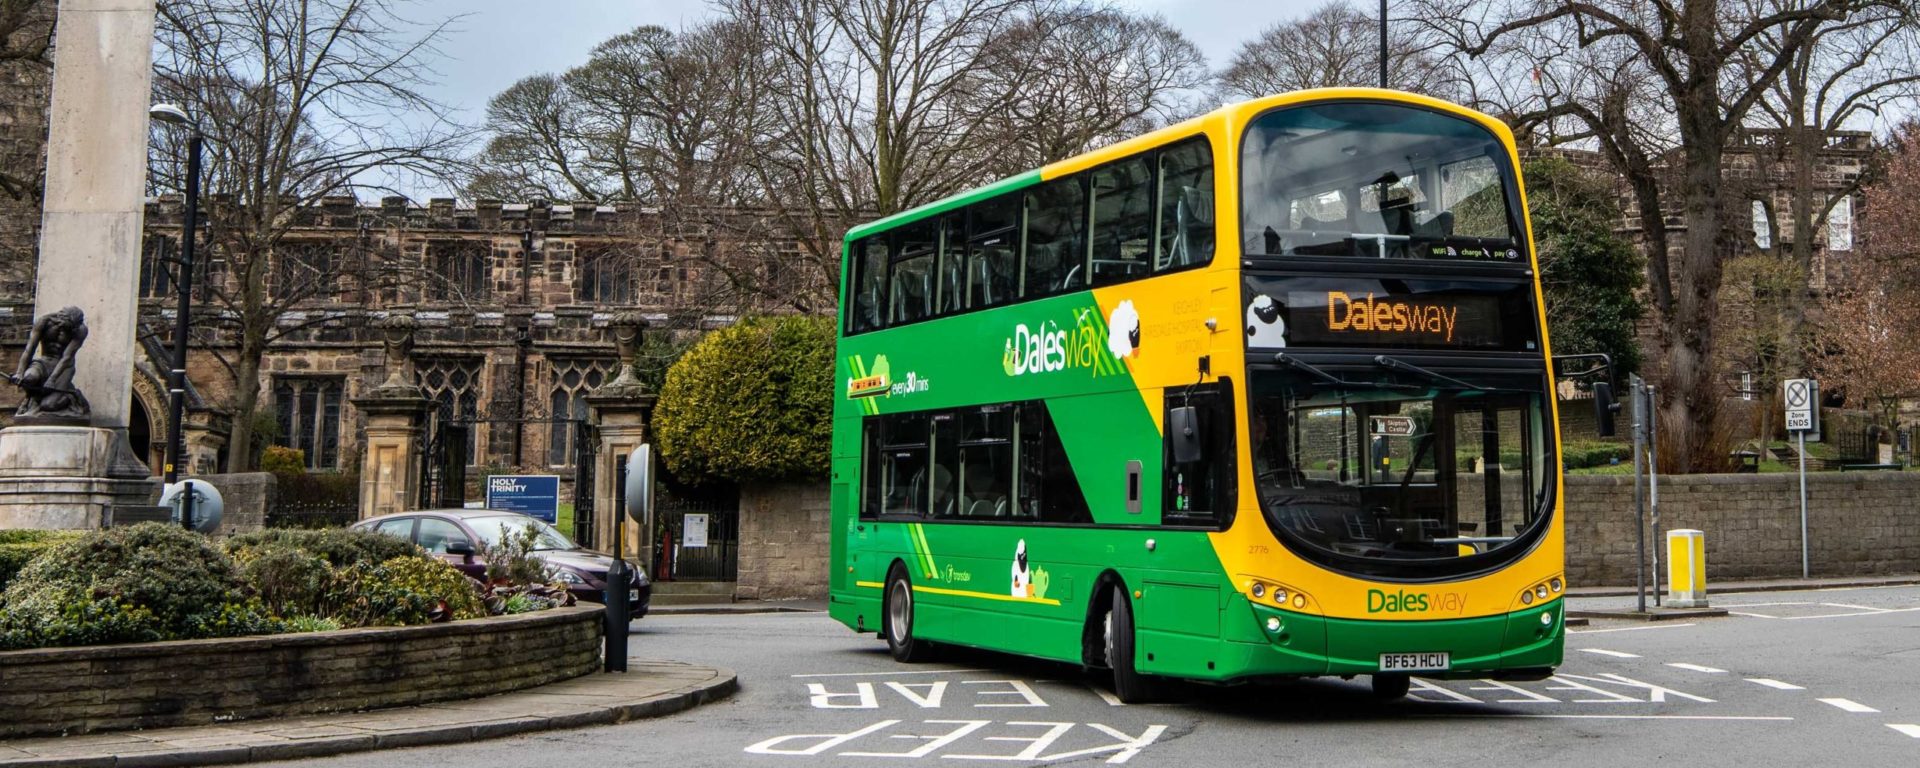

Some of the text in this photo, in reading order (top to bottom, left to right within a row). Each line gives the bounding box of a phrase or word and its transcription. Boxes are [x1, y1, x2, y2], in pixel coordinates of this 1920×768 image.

[1461, 249, 1482, 257] charge
[1328, 291, 1457, 342] Dalesway
[1014, 321, 1104, 378] Dalesway
[891, 371, 929, 398] every 30 mins
[1788, 419, 1809, 427] ENDS
[490, 485, 527, 493] TRINITY
[492, 478, 517, 486] HOLY
[1367, 588, 1468, 616] Dalesway
[1385, 654, 1444, 668] BF63 HCU
[807, 679, 1127, 709] LEAR
[743, 719, 1169, 764] KEEP
